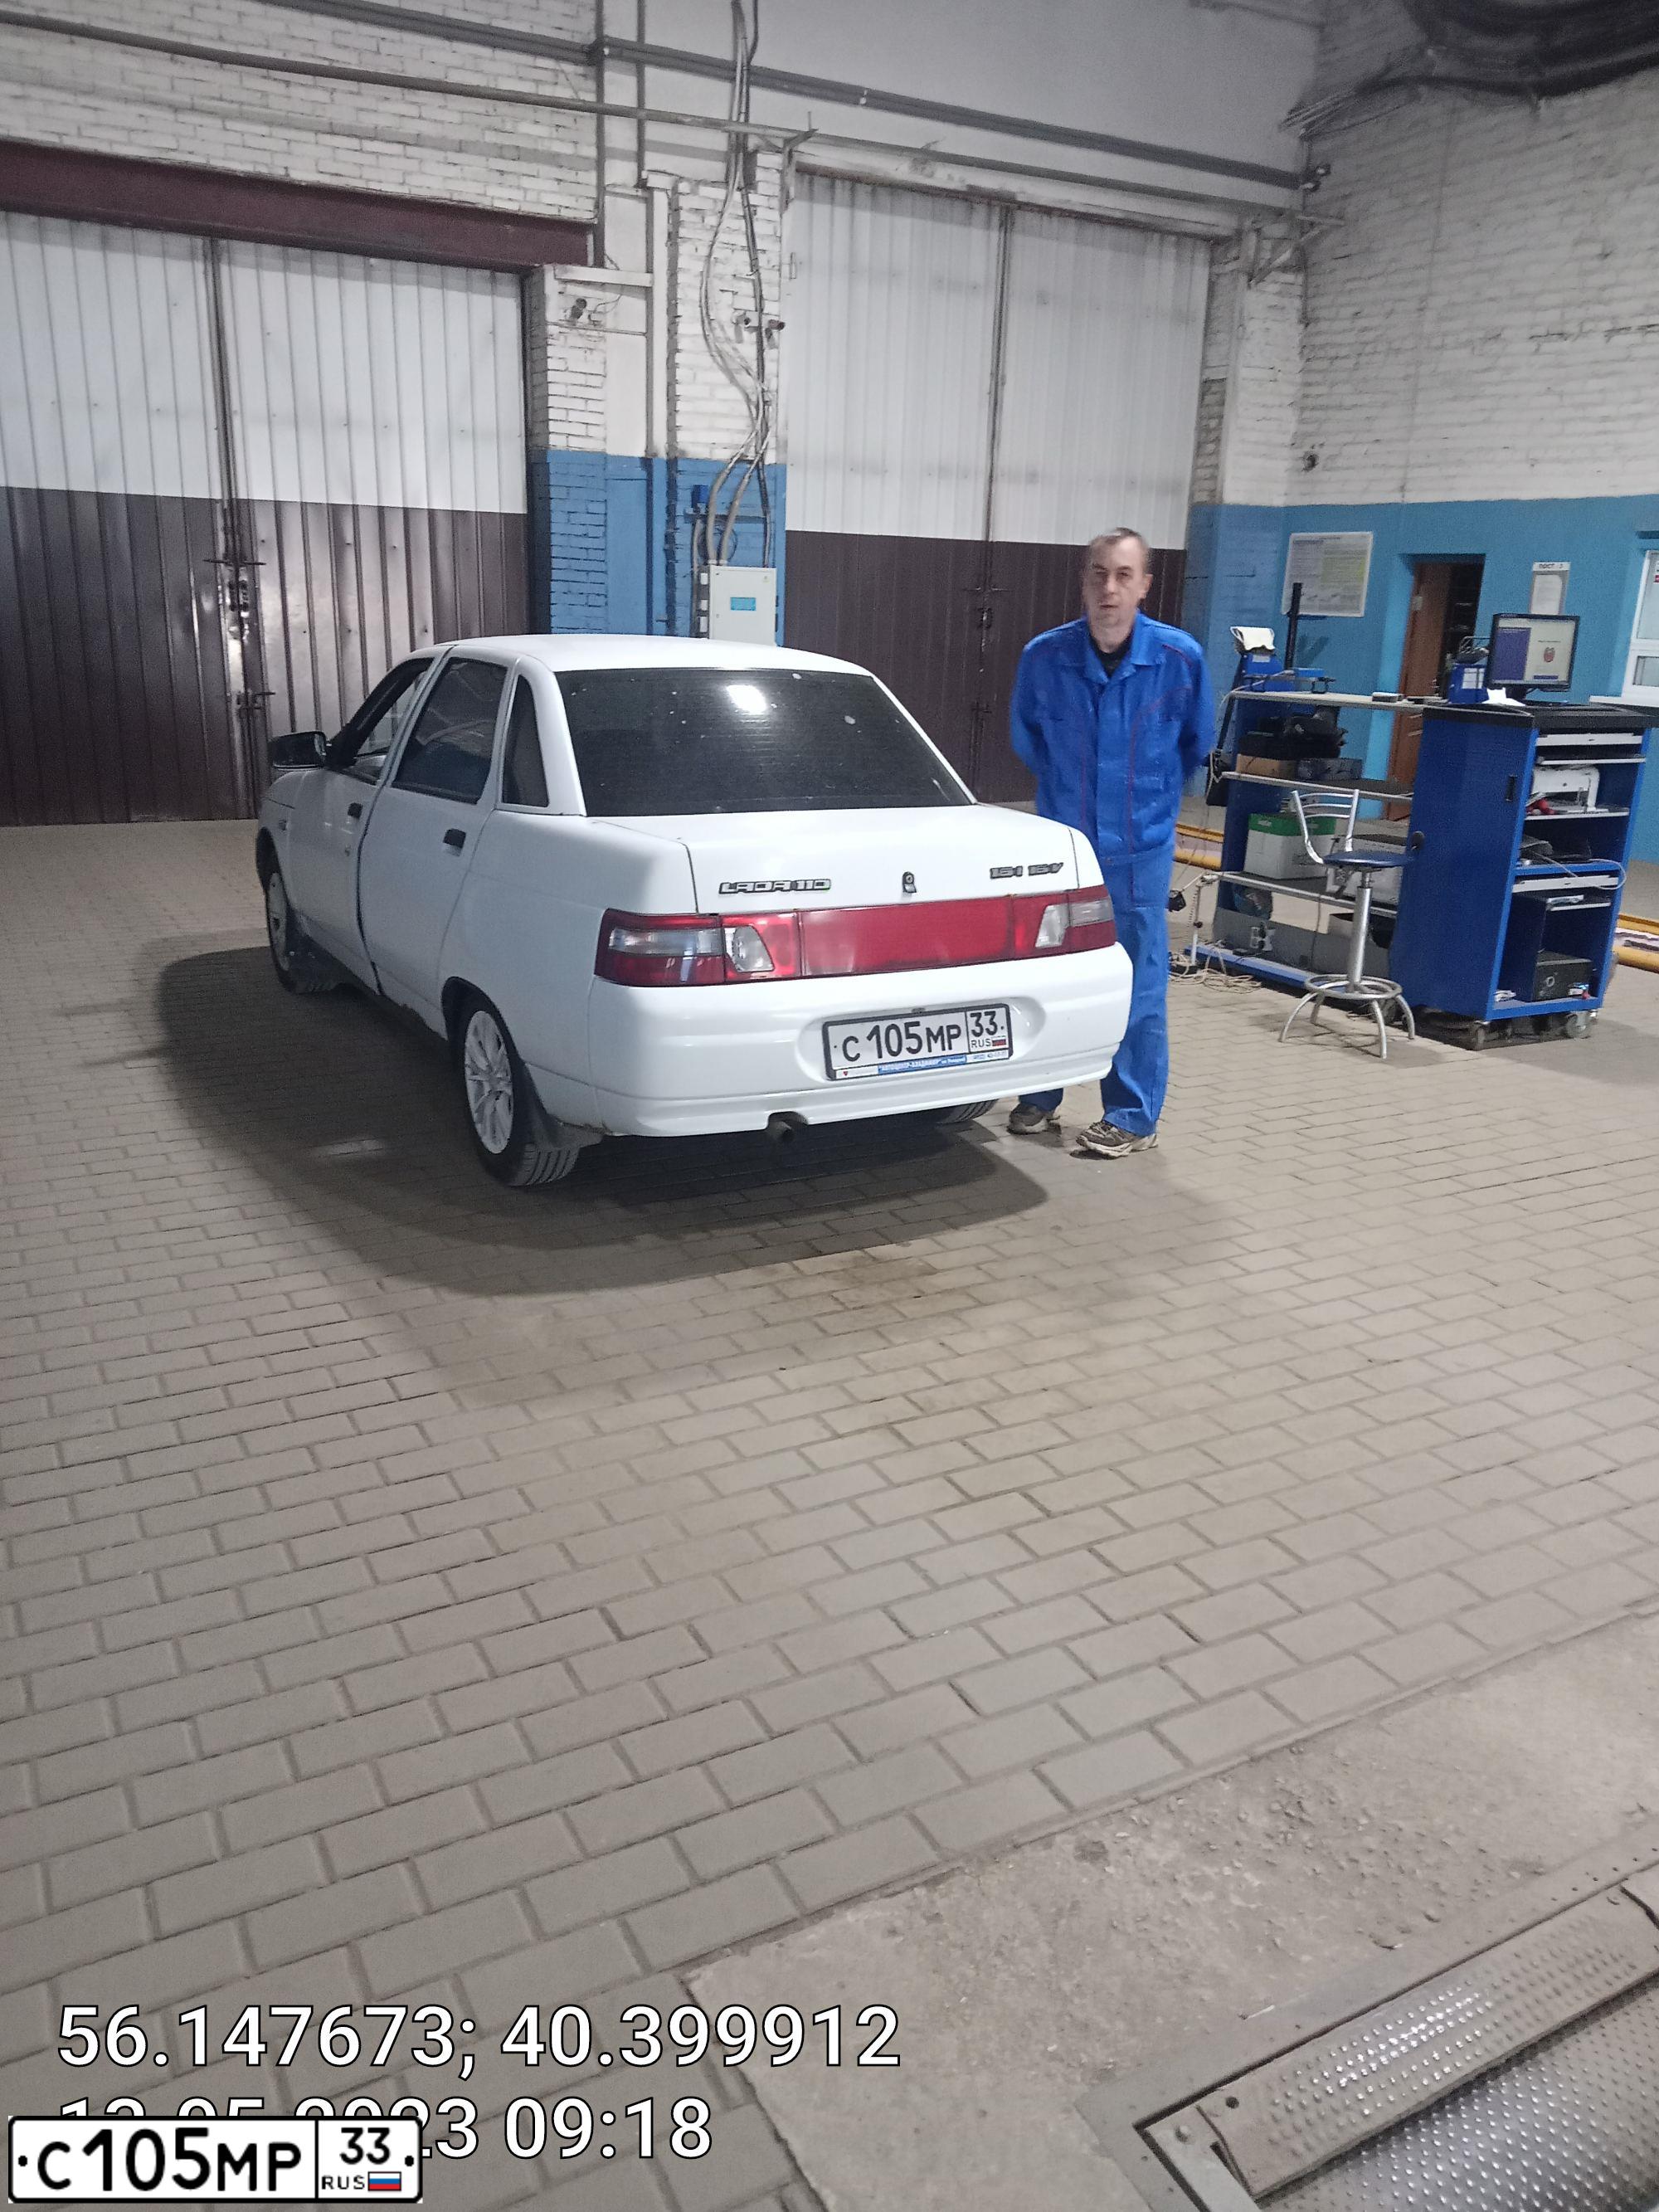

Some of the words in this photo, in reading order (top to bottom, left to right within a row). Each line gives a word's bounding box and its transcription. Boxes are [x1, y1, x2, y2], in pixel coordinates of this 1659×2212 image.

[719, 880, 791, 894] LADA
[795, 878, 831, 892] 110
[969, 1010, 999, 1037] 33
[971, 1038, 991, 1049] RUS
